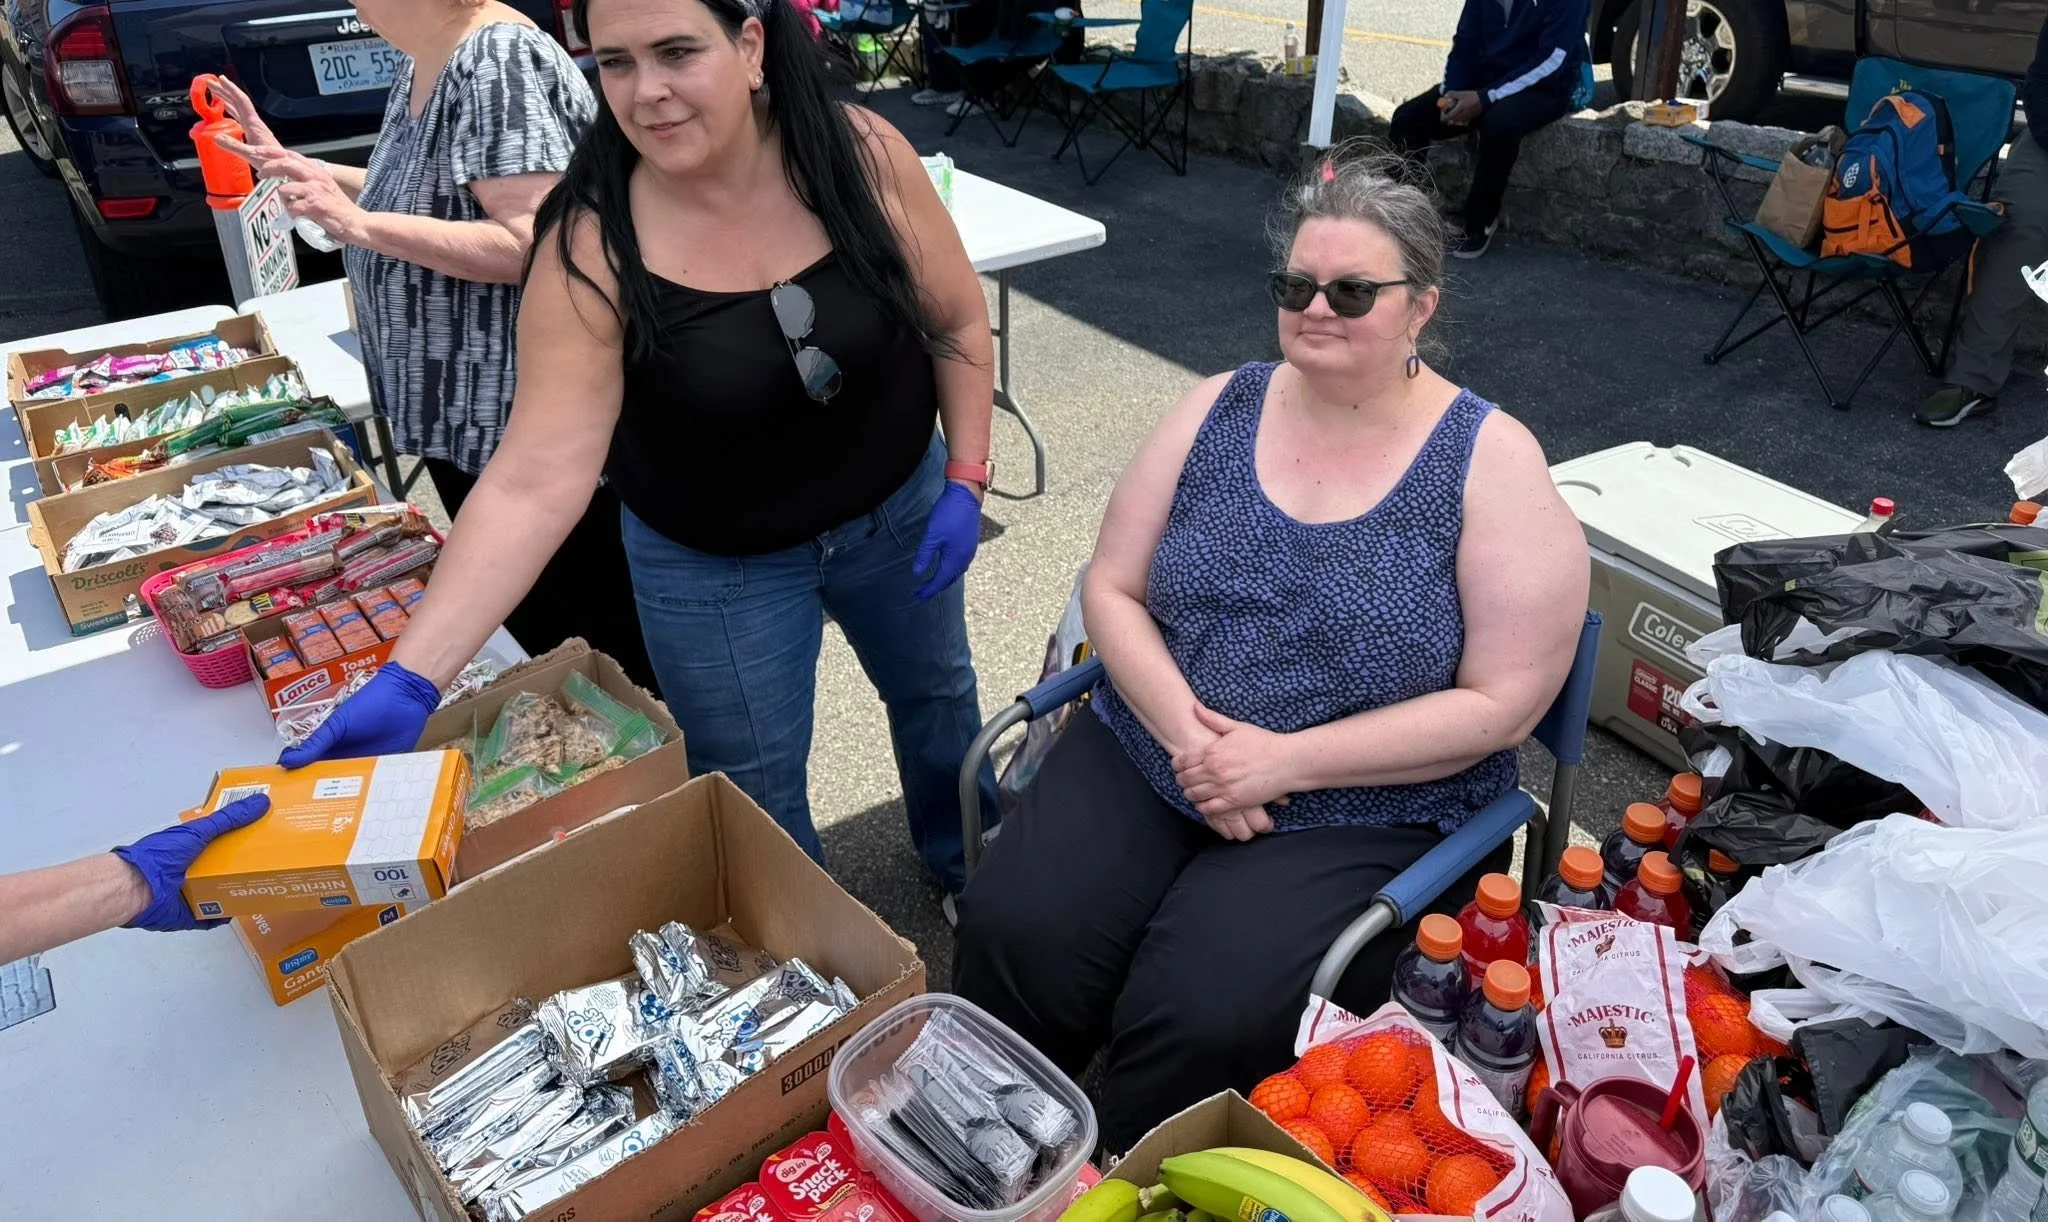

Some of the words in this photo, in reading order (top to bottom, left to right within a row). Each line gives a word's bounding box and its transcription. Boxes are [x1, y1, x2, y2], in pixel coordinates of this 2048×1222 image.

[337, 18, 379, 34] Jee
[320, 55, 359, 81] 2DC
[370, 49, 400, 74] 55
[251, 210, 271, 259] NO
[260, 237, 288, 288] SMOKING
[72, 562, 146, 590] Driscoll's
[80, 613, 123, 630] Sweetest
[1643, 613, 1693, 652] Cole
[340, 654, 377, 673] Toast
[279, 673, 326, 707] Lance
[1662, 683, 1683, 709] 120
[1660, 717, 1679, 735] USA
[374, 868, 410, 882] 100
[230, 884, 288, 897] Gloves
[291, 879, 346, 893] Nitrile
[203, 903, 220, 914] XL
[383, 911, 395, 922] M
[252, 913, 272, 935] oves
[285, 952, 313, 972] Inspire
[1611, 950, 1641, 960] CITRUS
[1569, 1004, 1653, 1028] MAJESTIC
[1626, 1052, 1658, 1060] CITRUS
[783, 1049, 834, 1091] 30000
[781, 1165, 797, 1179] dig
[795, 1159, 807, 1170] in!
[788, 1158, 841, 1200] Snack
[807, 1169, 849, 1203] pack
